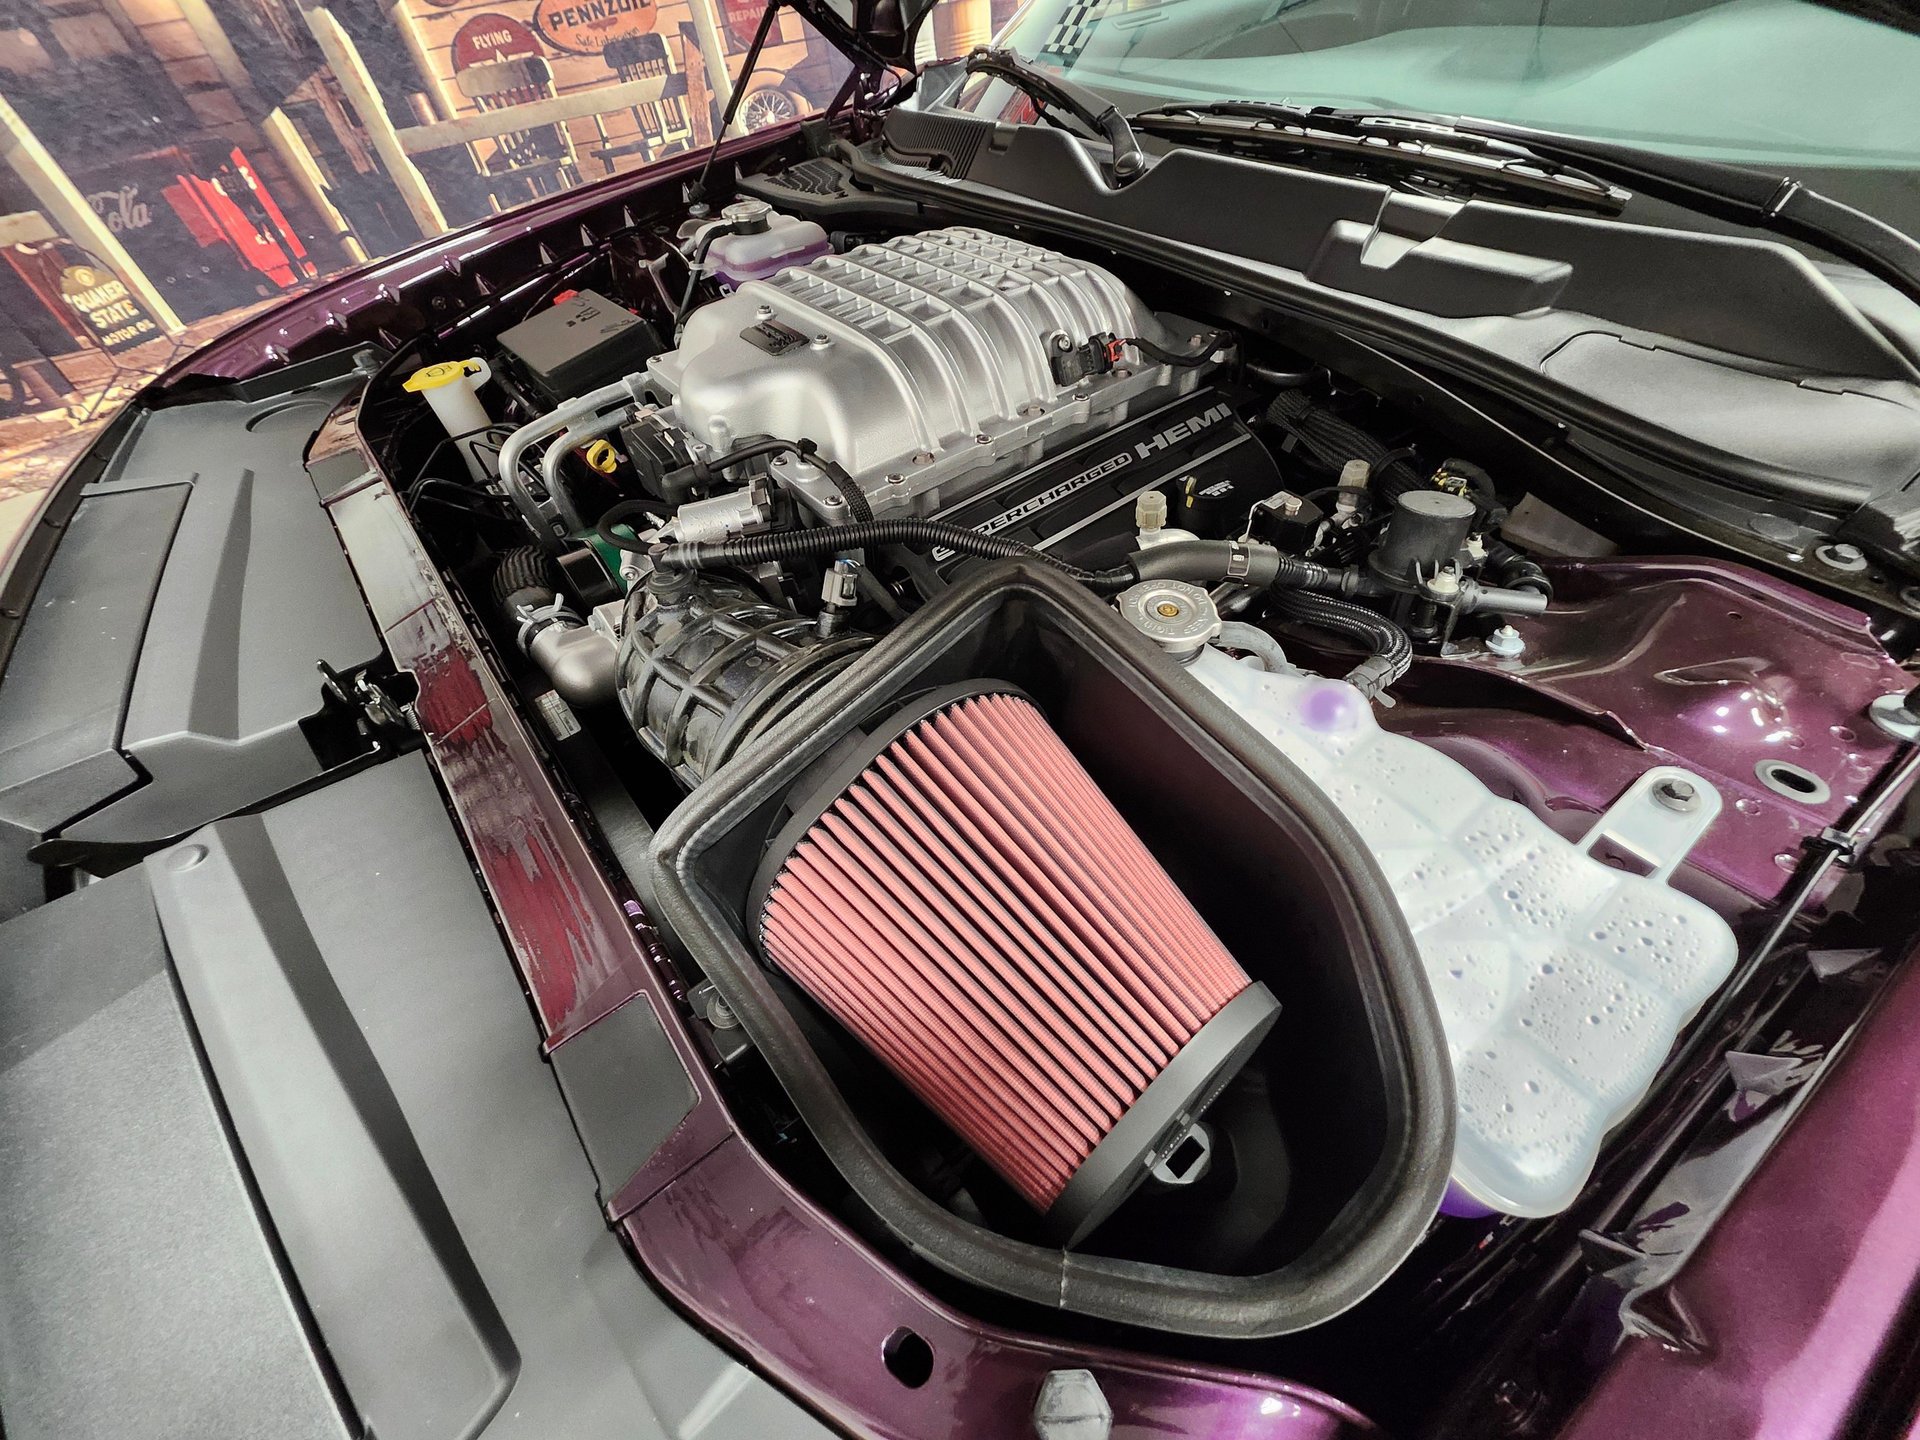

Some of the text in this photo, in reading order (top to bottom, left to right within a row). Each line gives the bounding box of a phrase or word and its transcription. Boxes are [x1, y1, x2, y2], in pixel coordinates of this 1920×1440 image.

[472, 29, 513, 50] FLYING
[89, 299, 140, 329] STATE
[1135, 402, 1233, 460] HEMI
